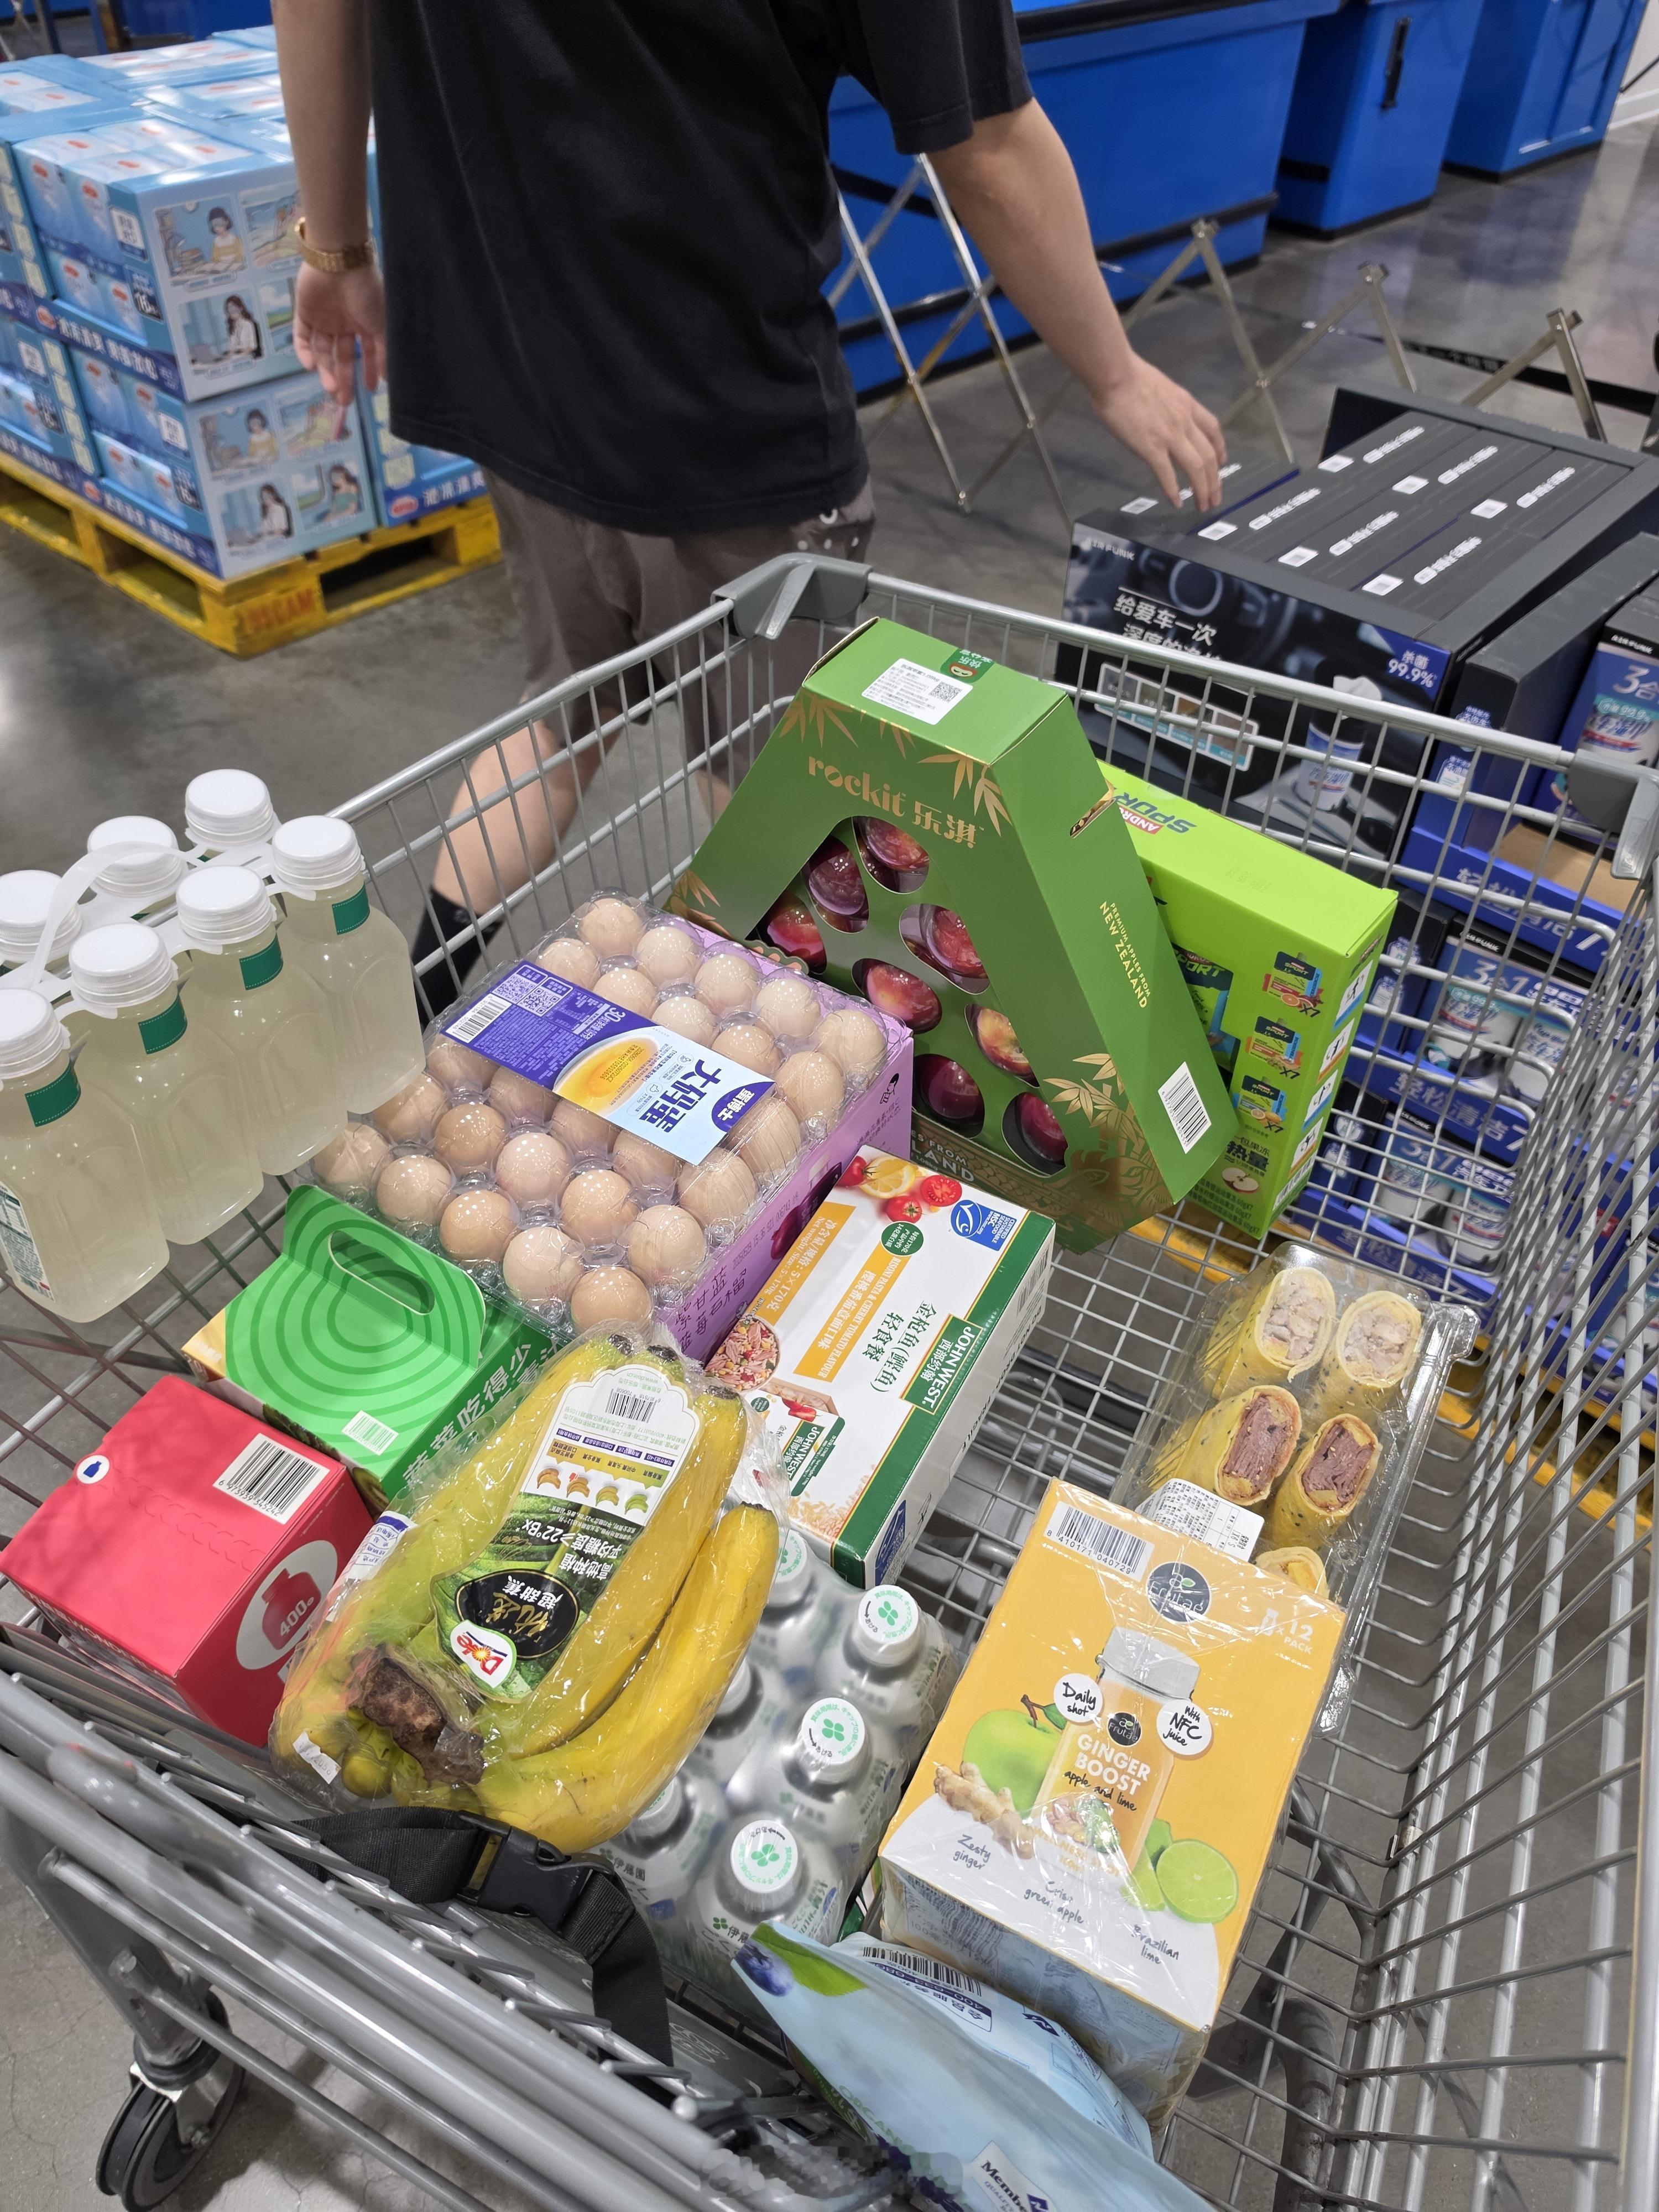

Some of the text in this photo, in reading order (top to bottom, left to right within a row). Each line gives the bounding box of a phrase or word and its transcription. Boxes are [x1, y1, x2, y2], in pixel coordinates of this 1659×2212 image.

[1113, 592, 1217, 647] 给爱车一次
[957, 655, 982, 669] 快乐
[1387, 658, 1436, 687] 99.9%
[1401, 650, 1431, 670] 杀菌
[808, 755, 906, 817] rockit
[912, 801, 978, 849] 乐淇
[1115, 791, 1198, 833] SPOR
[1098, 901, 1147, 1010] NEW ZEALAND
[1109, 902, 1151, 998] PREMIUM APPLES FROM
[1176, 949, 1226, 977] PORT
[638, 1057, 728, 1135] 大码蛋
[714, 1087, 755, 1124] 蛋博士
[930, 1139, 967, 1166] FROM
[1225, 1139, 1269, 1173] 热量
[987, 1212, 1000, 1227] MSC
[990, 1214, 1005, 1234] SEAFOOD
[990, 1216, 1010, 1244] SUSTAINABLE
[999, 1218, 1015, 1239] CERTIFIED
[784, 1251, 800, 1269] Size:
[881, 1256, 901, 1279] RISONI
[672, 1262, 729, 1335] 紫甘蓝
[870, 1275, 888, 1296] PASTA
[852, 1298, 873, 1324] CHERRY
[836, 1322, 858, 1350] TOMATO
[860, 1308, 905, 1365] 轻食餐
[942, 1326, 979, 1366] JOHN
[817, 1347, 841, 1380] FLAVOUR
[917, 1338, 956, 1383] 西部约翰
[799, 1425, 821, 1454] JOHN
[227, 1483, 254, 1501] 973939
[253, 1498, 281, 1516] 345242
[557, 1551, 614, 1581] 高地种植
[1058, 1535, 1092, 1557] 410171
[1097, 1553, 1132, 1575] 040729
[500, 1574, 563, 1611] 超甜蕉
[1284, 1636, 1313, 1655] PACK
[1288, 1620, 1314, 1642] 12
[455, 1632, 505, 1677] Dole
[1062, 1682, 1097, 1710] Daily
[1067, 1704, 1089, 1717] shot
[1169, 1712, 1202, 1740] NFC
[1185, 1705, 1201, 1723] With
[1162, 1728, 1188, 1746] juice
[1078, 1734, 1151, 1782] GINGER
[1074, 1752, 1141, 1796] BOOST
[1064, 1770, 1137, 1811] apple and lime
[952, 1849, 985, 1871] ginger
[957, 1834, 992, 1863] Zesty
[613, 1856, 646, 1881] 伊藤園
[1023, 1886, 1084, 1924] green apple
[1132, 1924, 1180, 1961] Brazilian
[1140, 1943, 1161, 1965] lime
[980, 2160, 1027, 2212] Membe
